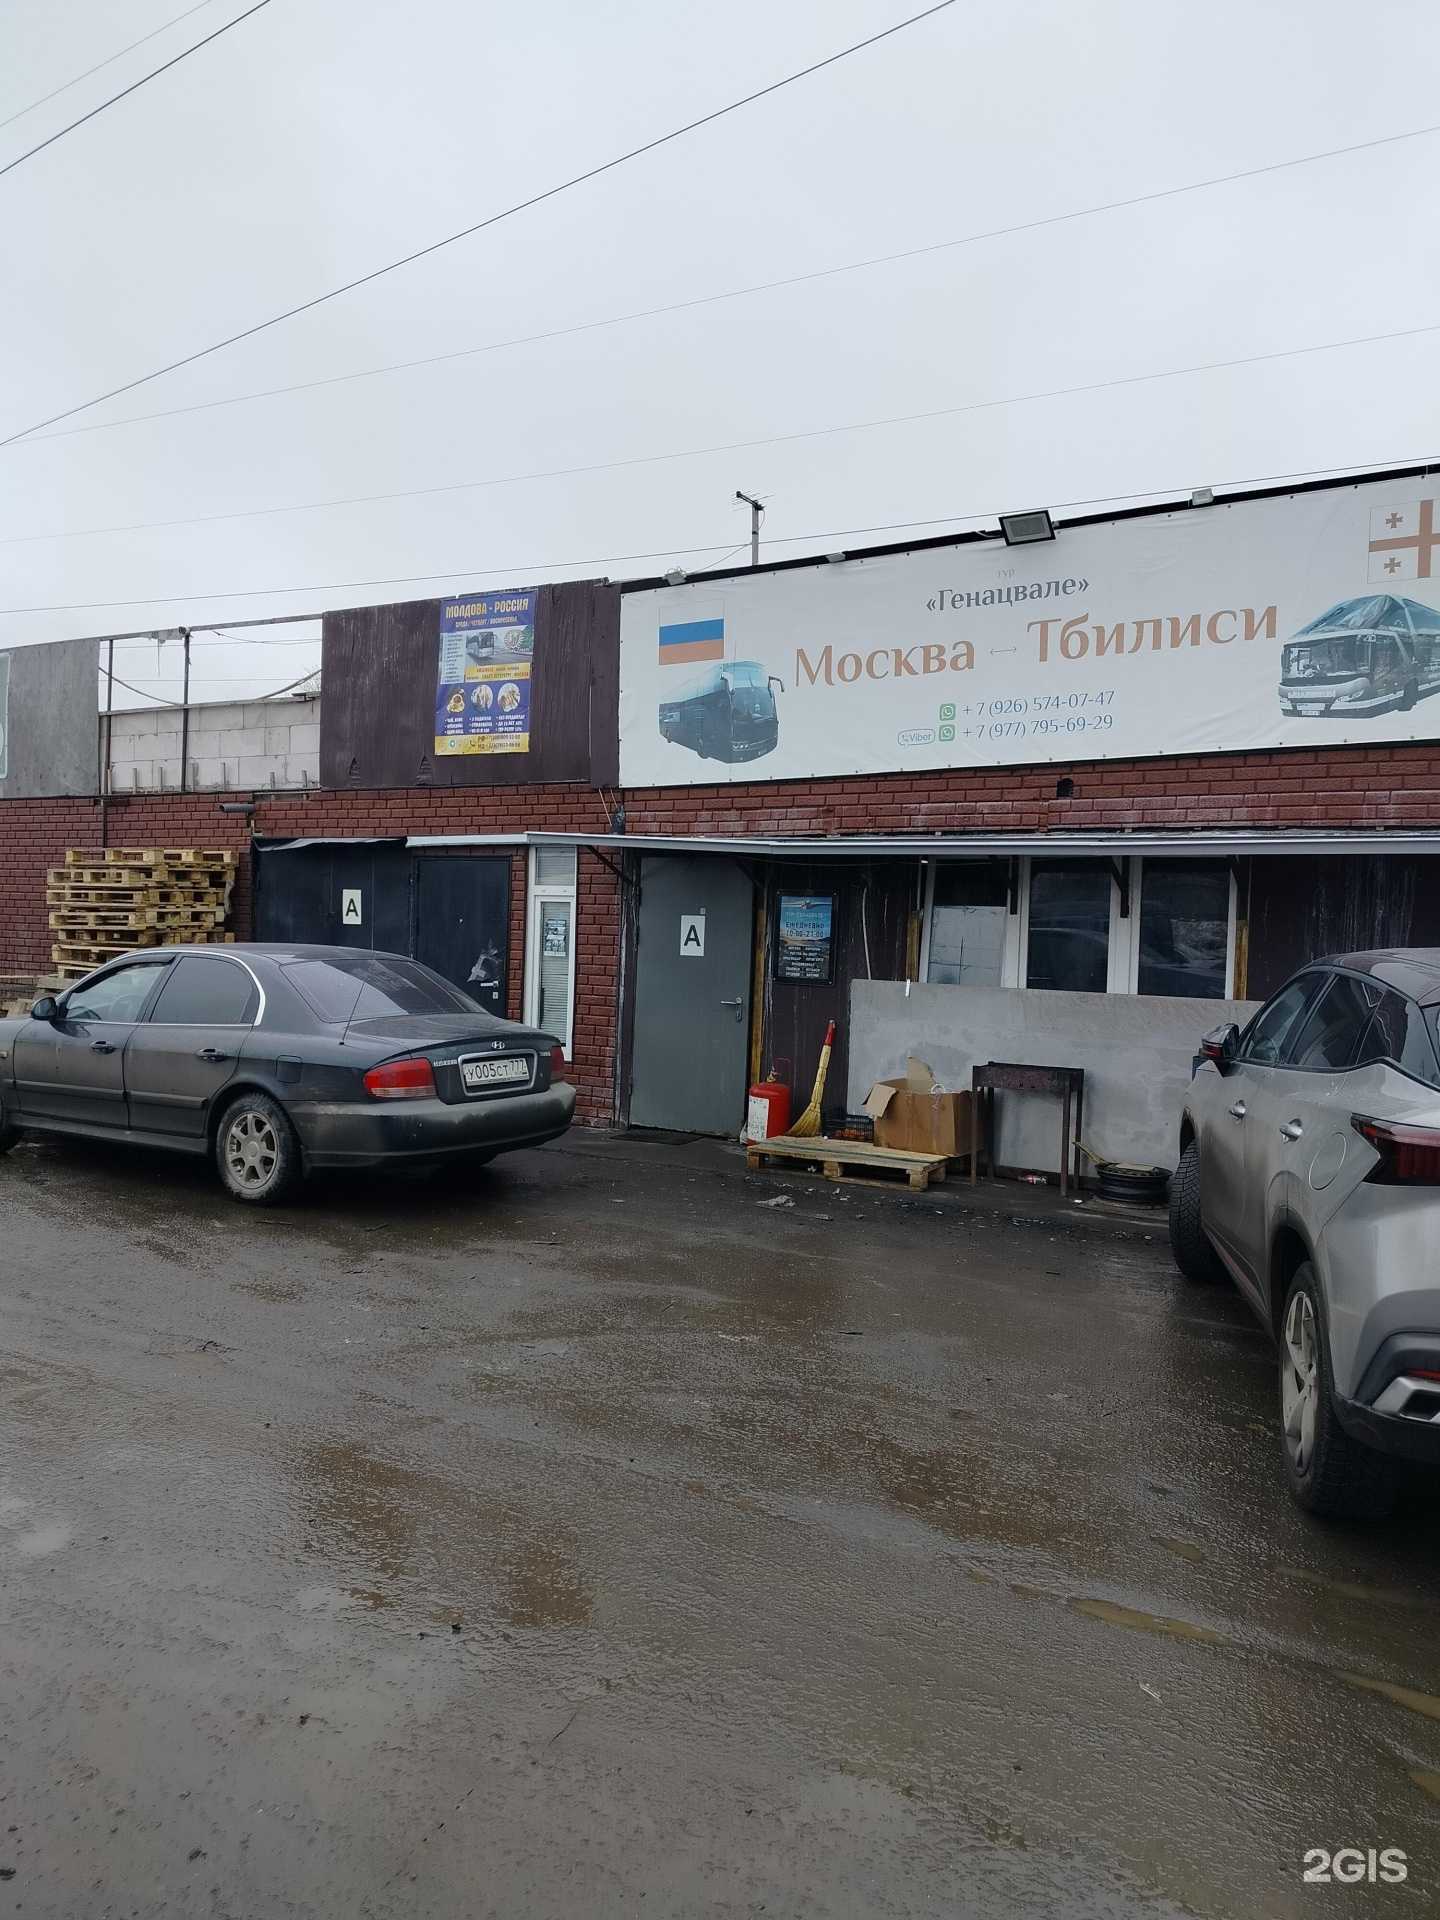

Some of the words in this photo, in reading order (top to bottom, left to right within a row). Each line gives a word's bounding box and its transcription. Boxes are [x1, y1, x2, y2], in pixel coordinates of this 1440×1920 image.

[926, 577, 1090, 611] «Генацвале»
[445, 602, 487, 619] МОЛДОВА
[494, 598, 529, 613] РОССИЯ
[795, 639, 976, 688] Москва
[1027, 605, 1278, 663] Тбилиси
[988, 699, 1029, 718] (926)
[1032, 690, 1115, 711] 574-07-47
[910, 731, 932, 742] Viber
[988, 720, 1026, 739] (977)
[1031, 714, 1114, 735] 795-69-29
[345, 898, 359, 917] А
[683, 924, 702, 947] А
